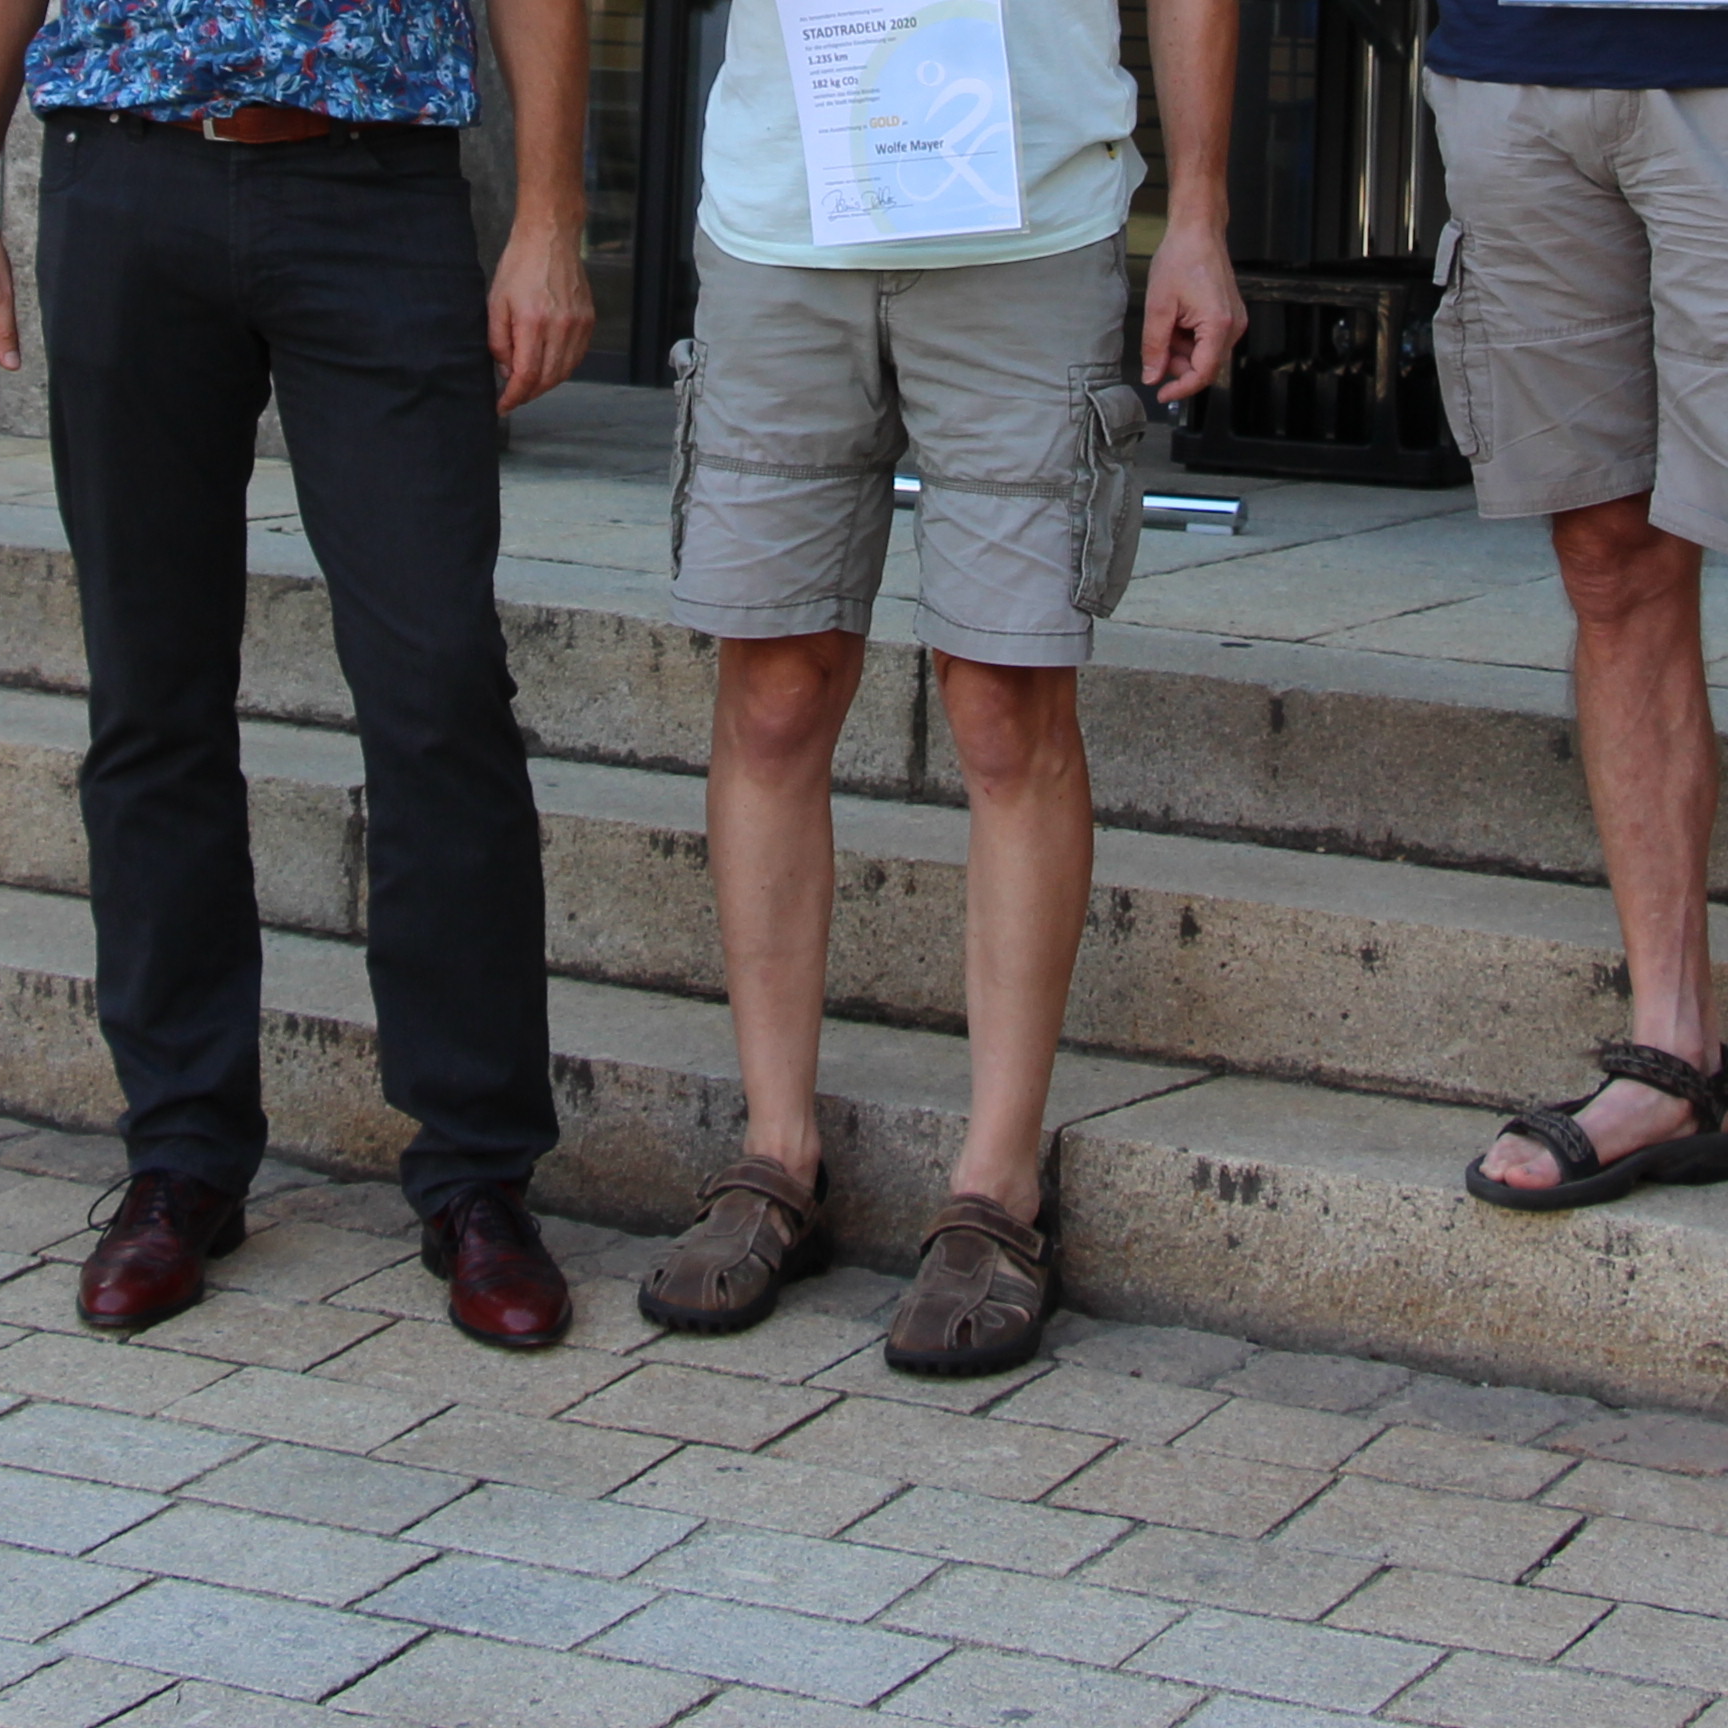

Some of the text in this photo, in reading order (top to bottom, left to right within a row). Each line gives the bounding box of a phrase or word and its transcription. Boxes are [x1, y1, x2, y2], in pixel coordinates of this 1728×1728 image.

[802, 16, 918, 41] STADTRADELN 2020
[808, 52, 849, 65] 1.235 km
[812, 79, 828, 90] 182
[830, 77, 841, 89] kg
[869, 115, 901, 128] GOLD
[875, 138, 945, 155] Wolfe Mayer
